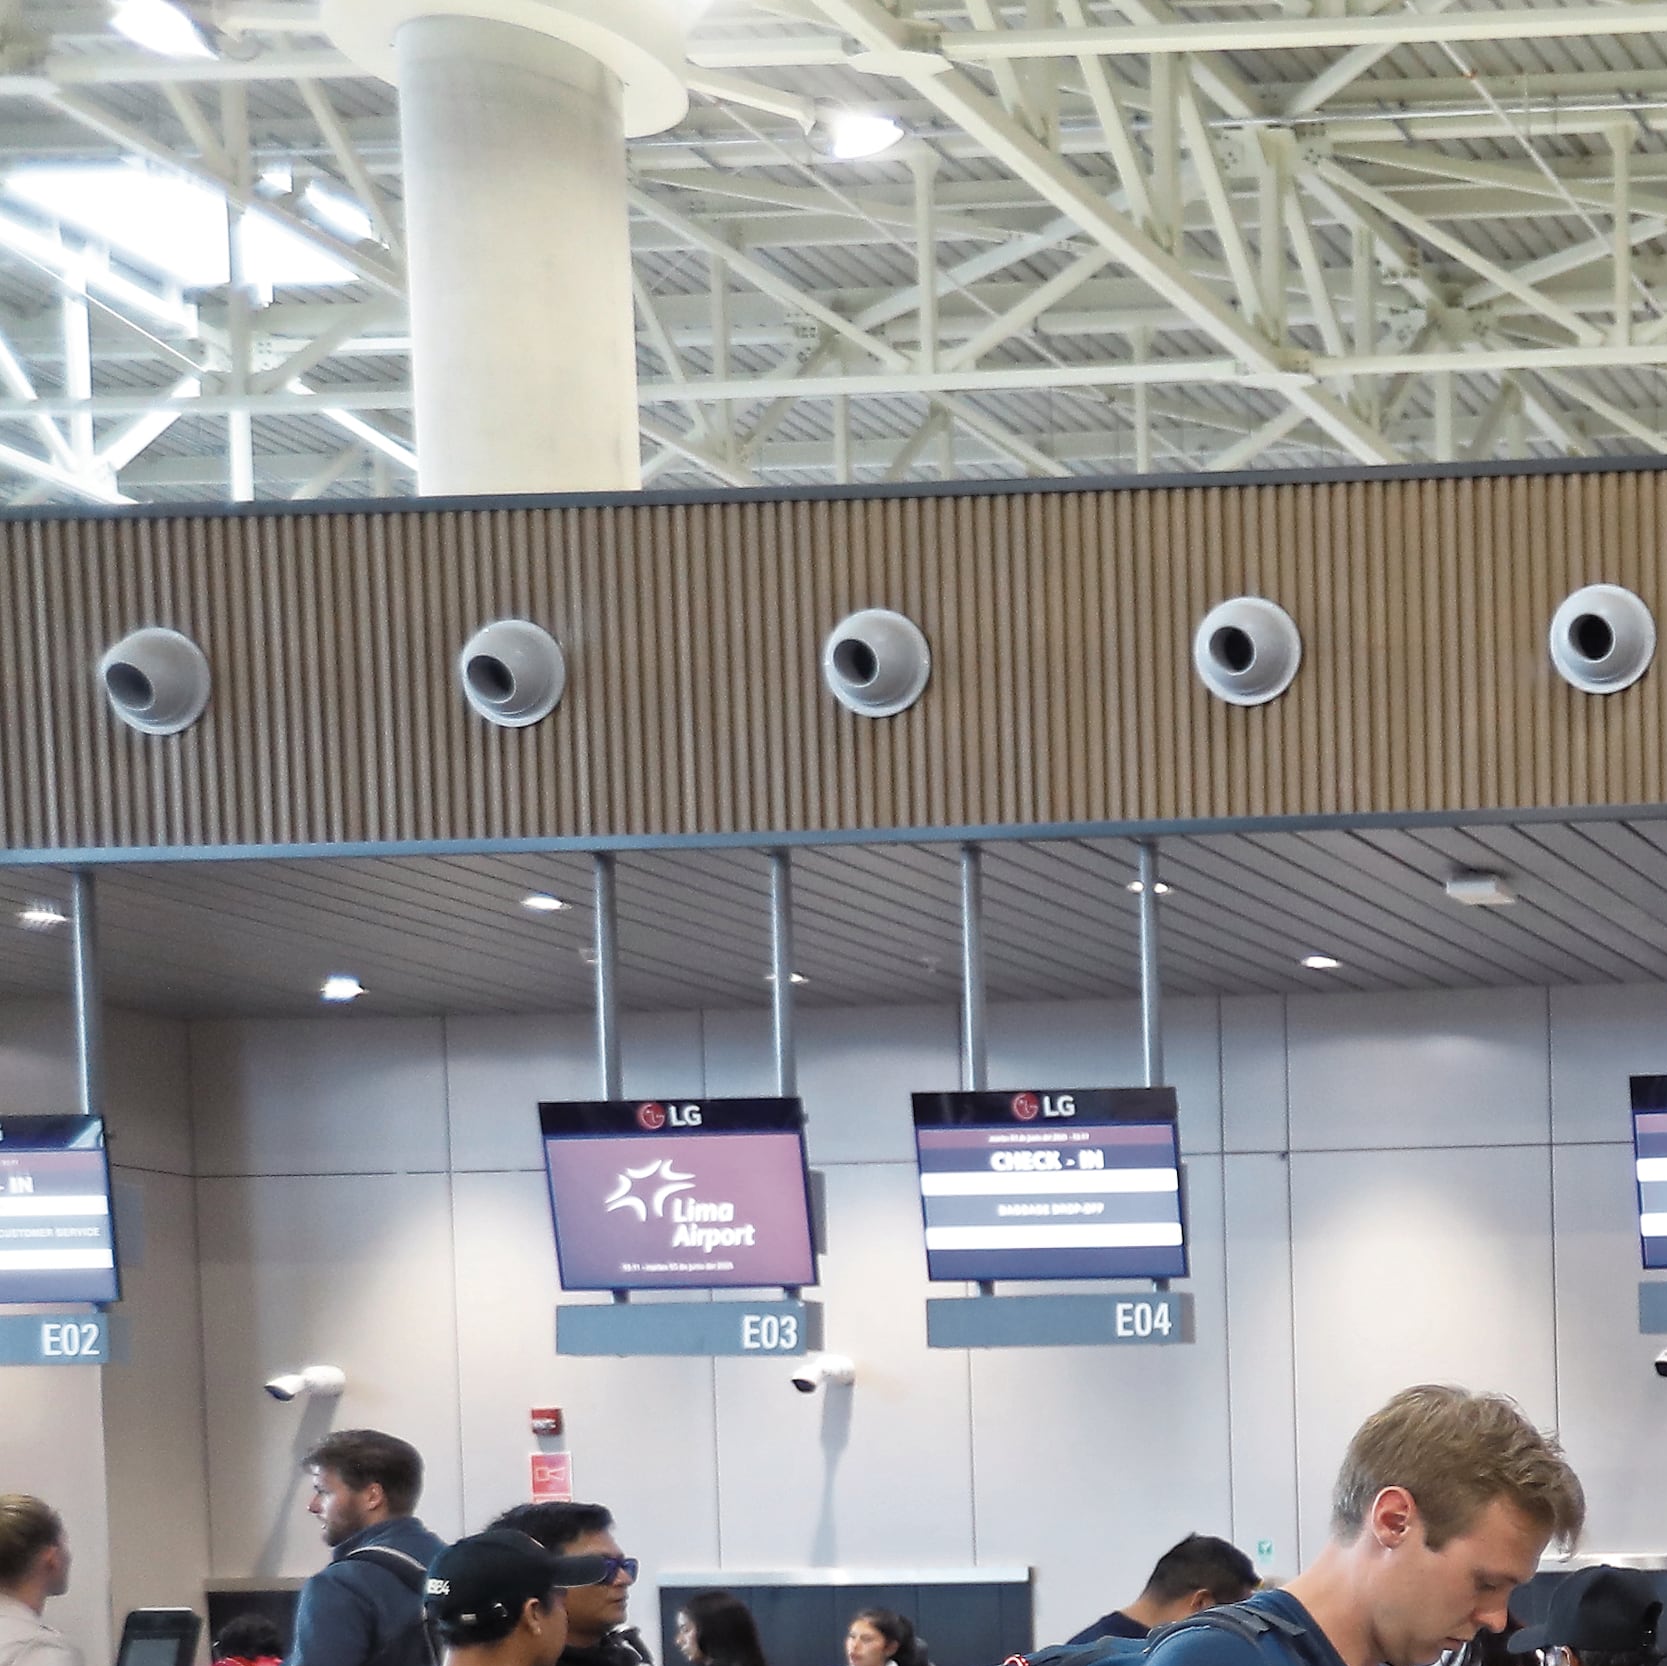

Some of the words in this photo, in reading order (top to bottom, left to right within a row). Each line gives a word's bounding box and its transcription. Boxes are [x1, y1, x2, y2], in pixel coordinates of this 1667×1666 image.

[668, 1105, 702, 1126] LG
[1043, 1095, 1075, 1117] LG
[9, 1176, 34, 1193] IN
[673, 1198, 734, 1223] Lima
[55, 1226, 100, 1238] SERVICE
[672, 1223, 756, 1253] Airport
[742, 1315, 798, 1349] E03
[1116, 1302, 1172, 1338] E04
[43, 1323, 100, 1356] E02
